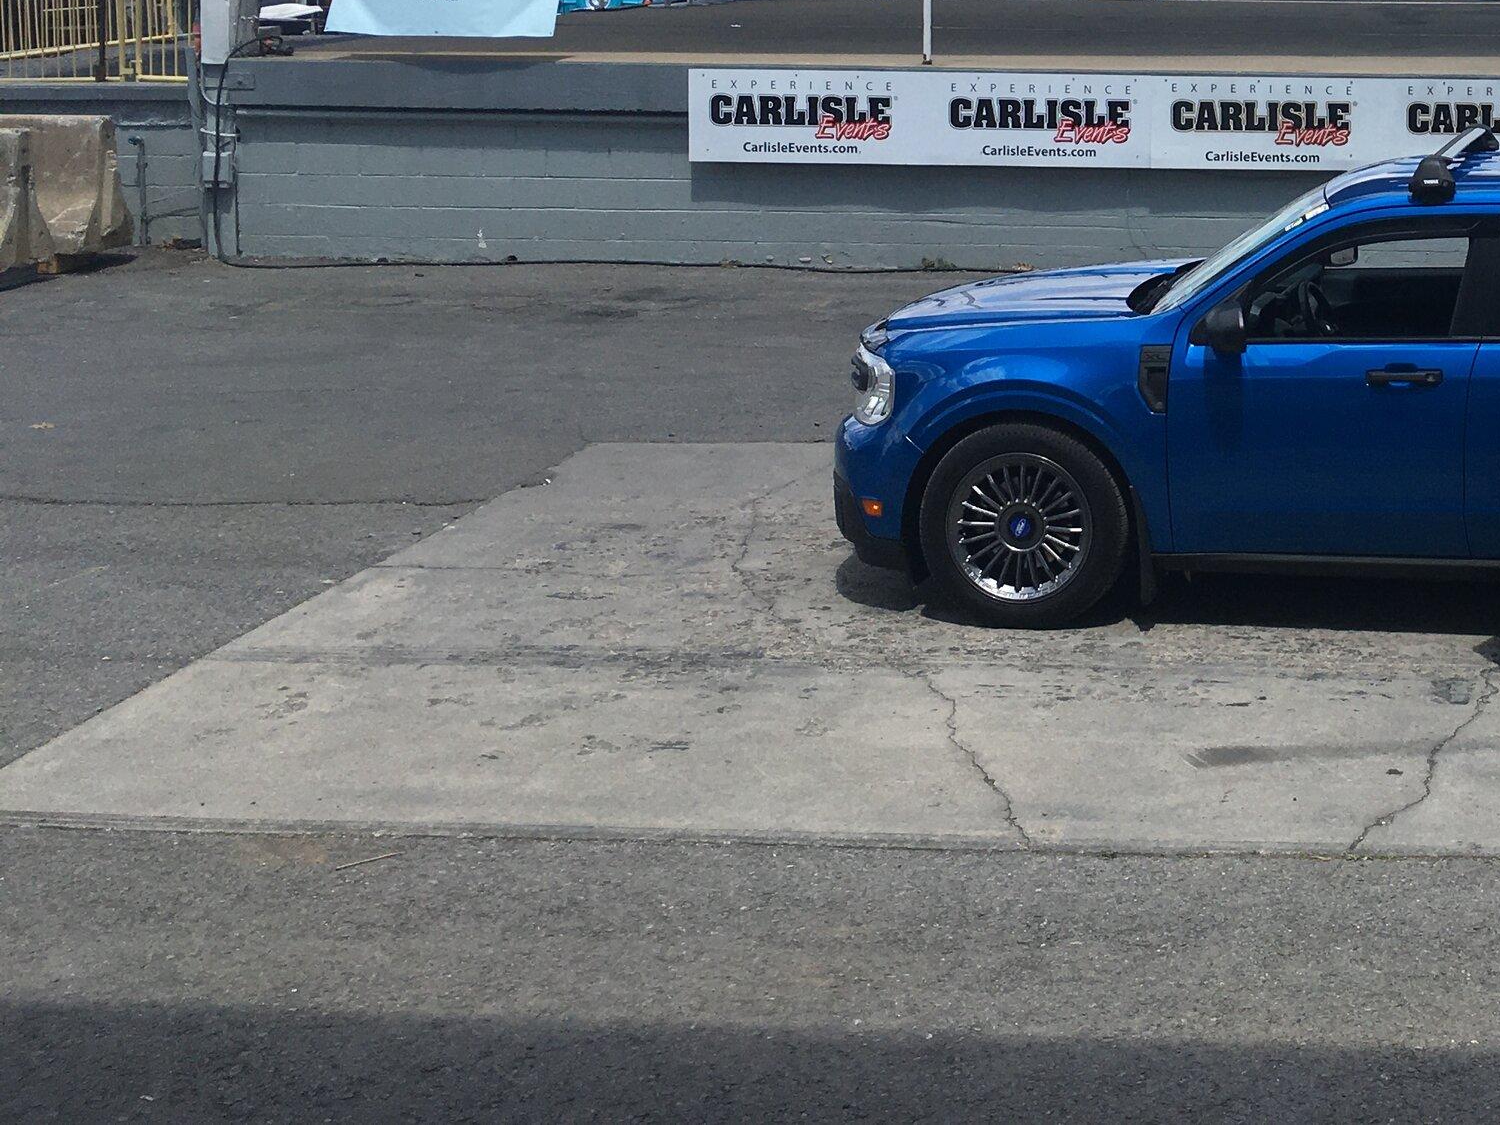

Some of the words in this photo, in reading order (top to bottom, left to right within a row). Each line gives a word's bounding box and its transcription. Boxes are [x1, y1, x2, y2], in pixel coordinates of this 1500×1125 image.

[711, 79, 892, 91] EXPERIENCE
[951, 83, 1132, 95] EXPERIENCE
[1171, 83, 1353, 95] EXPERIENCE
[709, 93, 893, 127] CARLISLE
[948, 96, 1131, 131] CARLISLE
[1171, 99, 1351, 133] CARLISLE
[815, 115, 892, 141] Events
[1054, 118, 1131, 144] Events
[1275, 121, 1351, 147] Events
[743, 141, 858, 154] CarlisleEvents.com
[982, 145, 1097, 158] CarlisleEvents.com
[1205, 150, 1321, 163] CarlisleEvents.com
